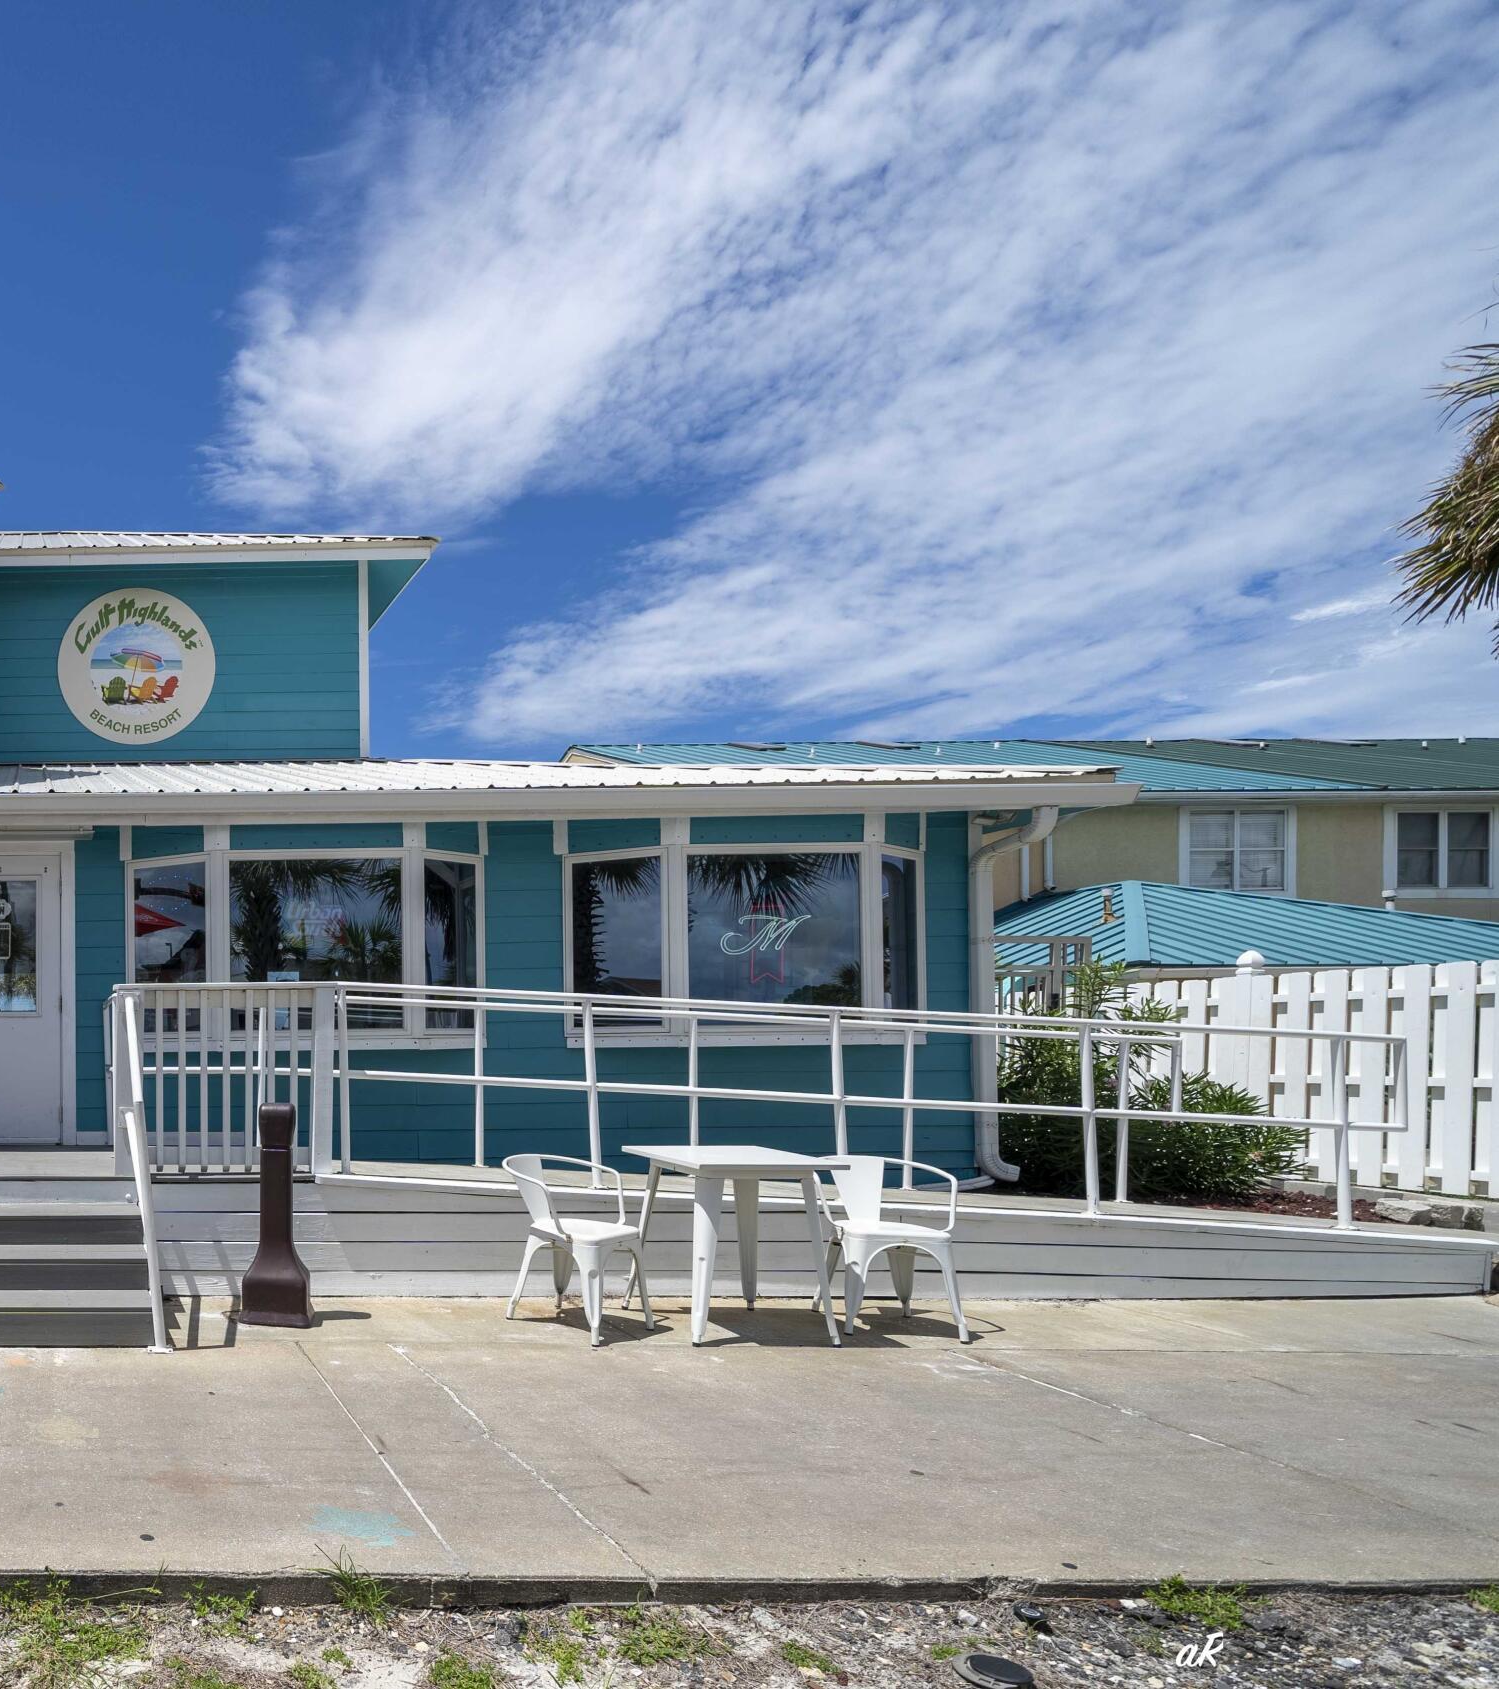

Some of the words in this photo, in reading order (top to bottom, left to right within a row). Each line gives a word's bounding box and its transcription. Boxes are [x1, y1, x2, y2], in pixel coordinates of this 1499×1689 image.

[75, 602, 116, 654] Gulf
[116, 597, 198, 650] Highlands
[89, 708, 130, 734] BEACH
[134, 708, 182, 735] RESORT
